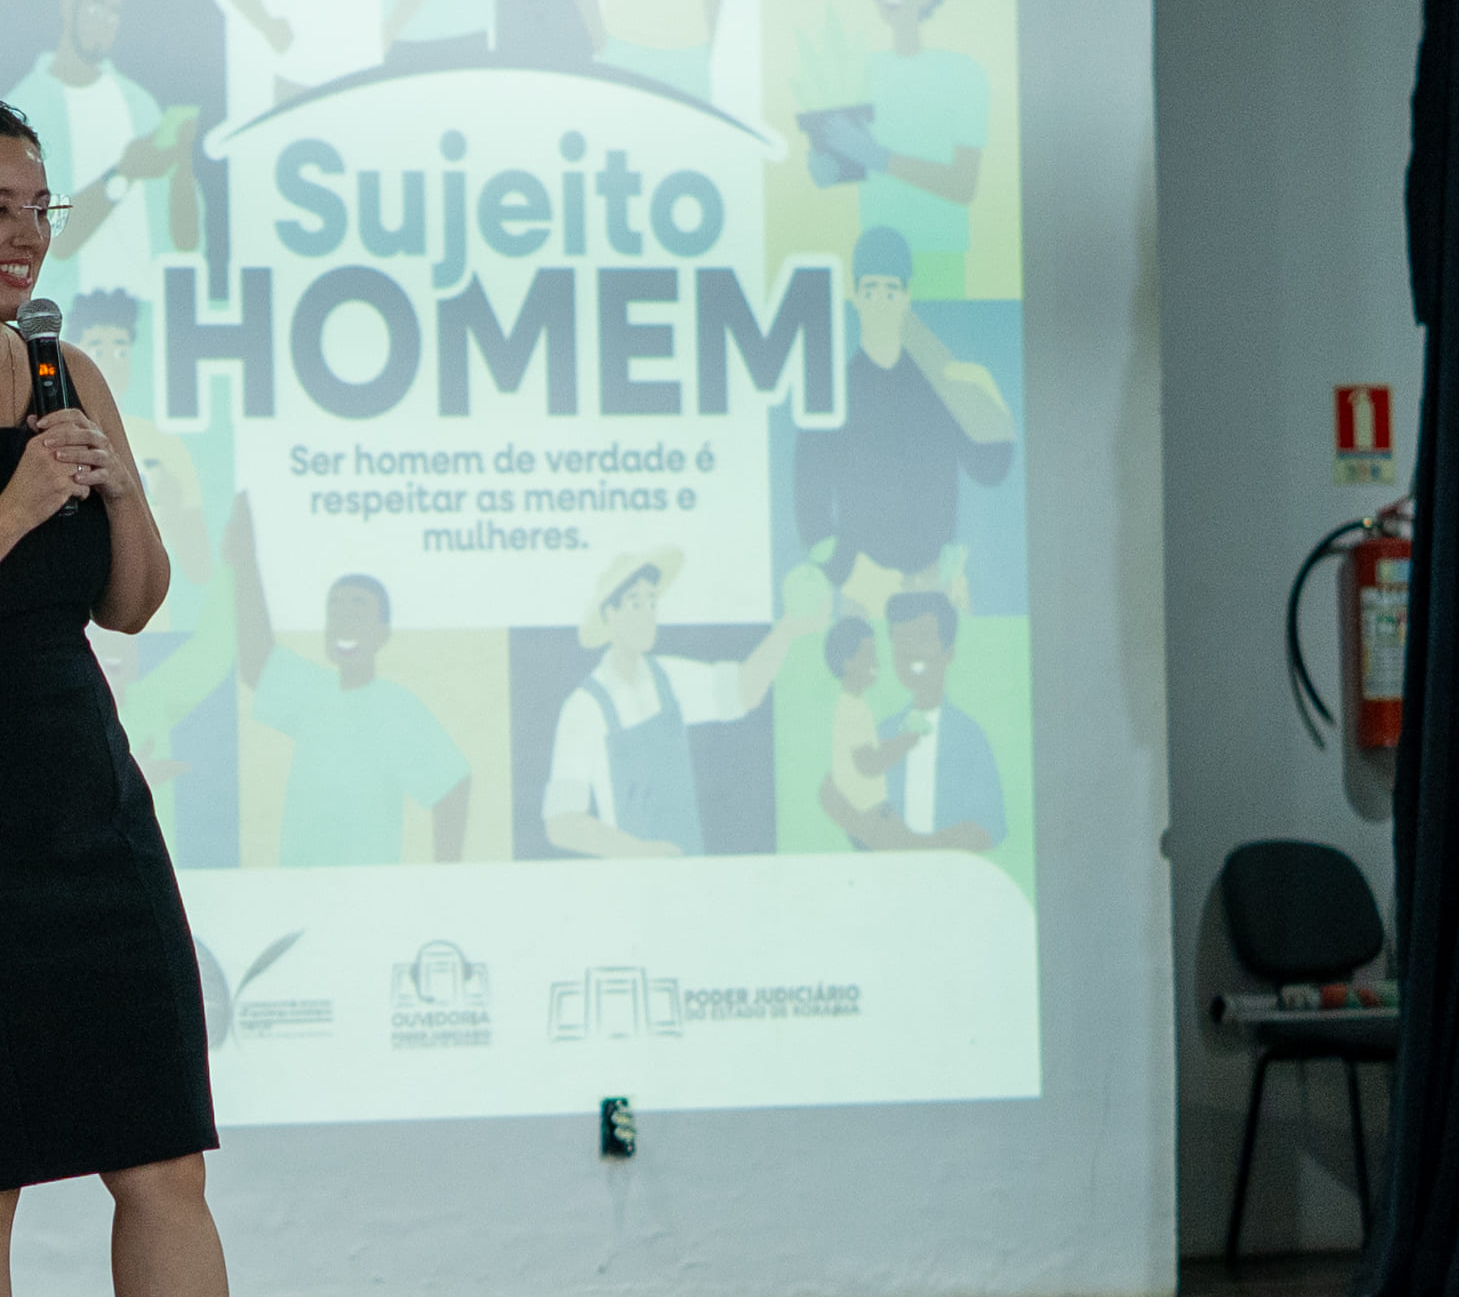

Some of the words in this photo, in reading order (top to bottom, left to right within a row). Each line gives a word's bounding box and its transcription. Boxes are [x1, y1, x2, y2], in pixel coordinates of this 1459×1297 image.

[275, 129, 725, 290] Sujeito
[163, 264, 835, 420] HOMEM
[290, 444, 345, 476] Ser
[354, 443, 484, 475] homem
[493, 443, 535, 474] de
[545, 441, 685, 473] verdade
[695, 440, 716, 472] é
[310, 482, 468, 521] respeitar
[476, 490, 514, 513] as
[524, 480, 668, 512] meninas
[677, 488, 697, 511] e
[423, 520, 590, 552] mulheres.
[684, 988, 748, 1005] PODER
